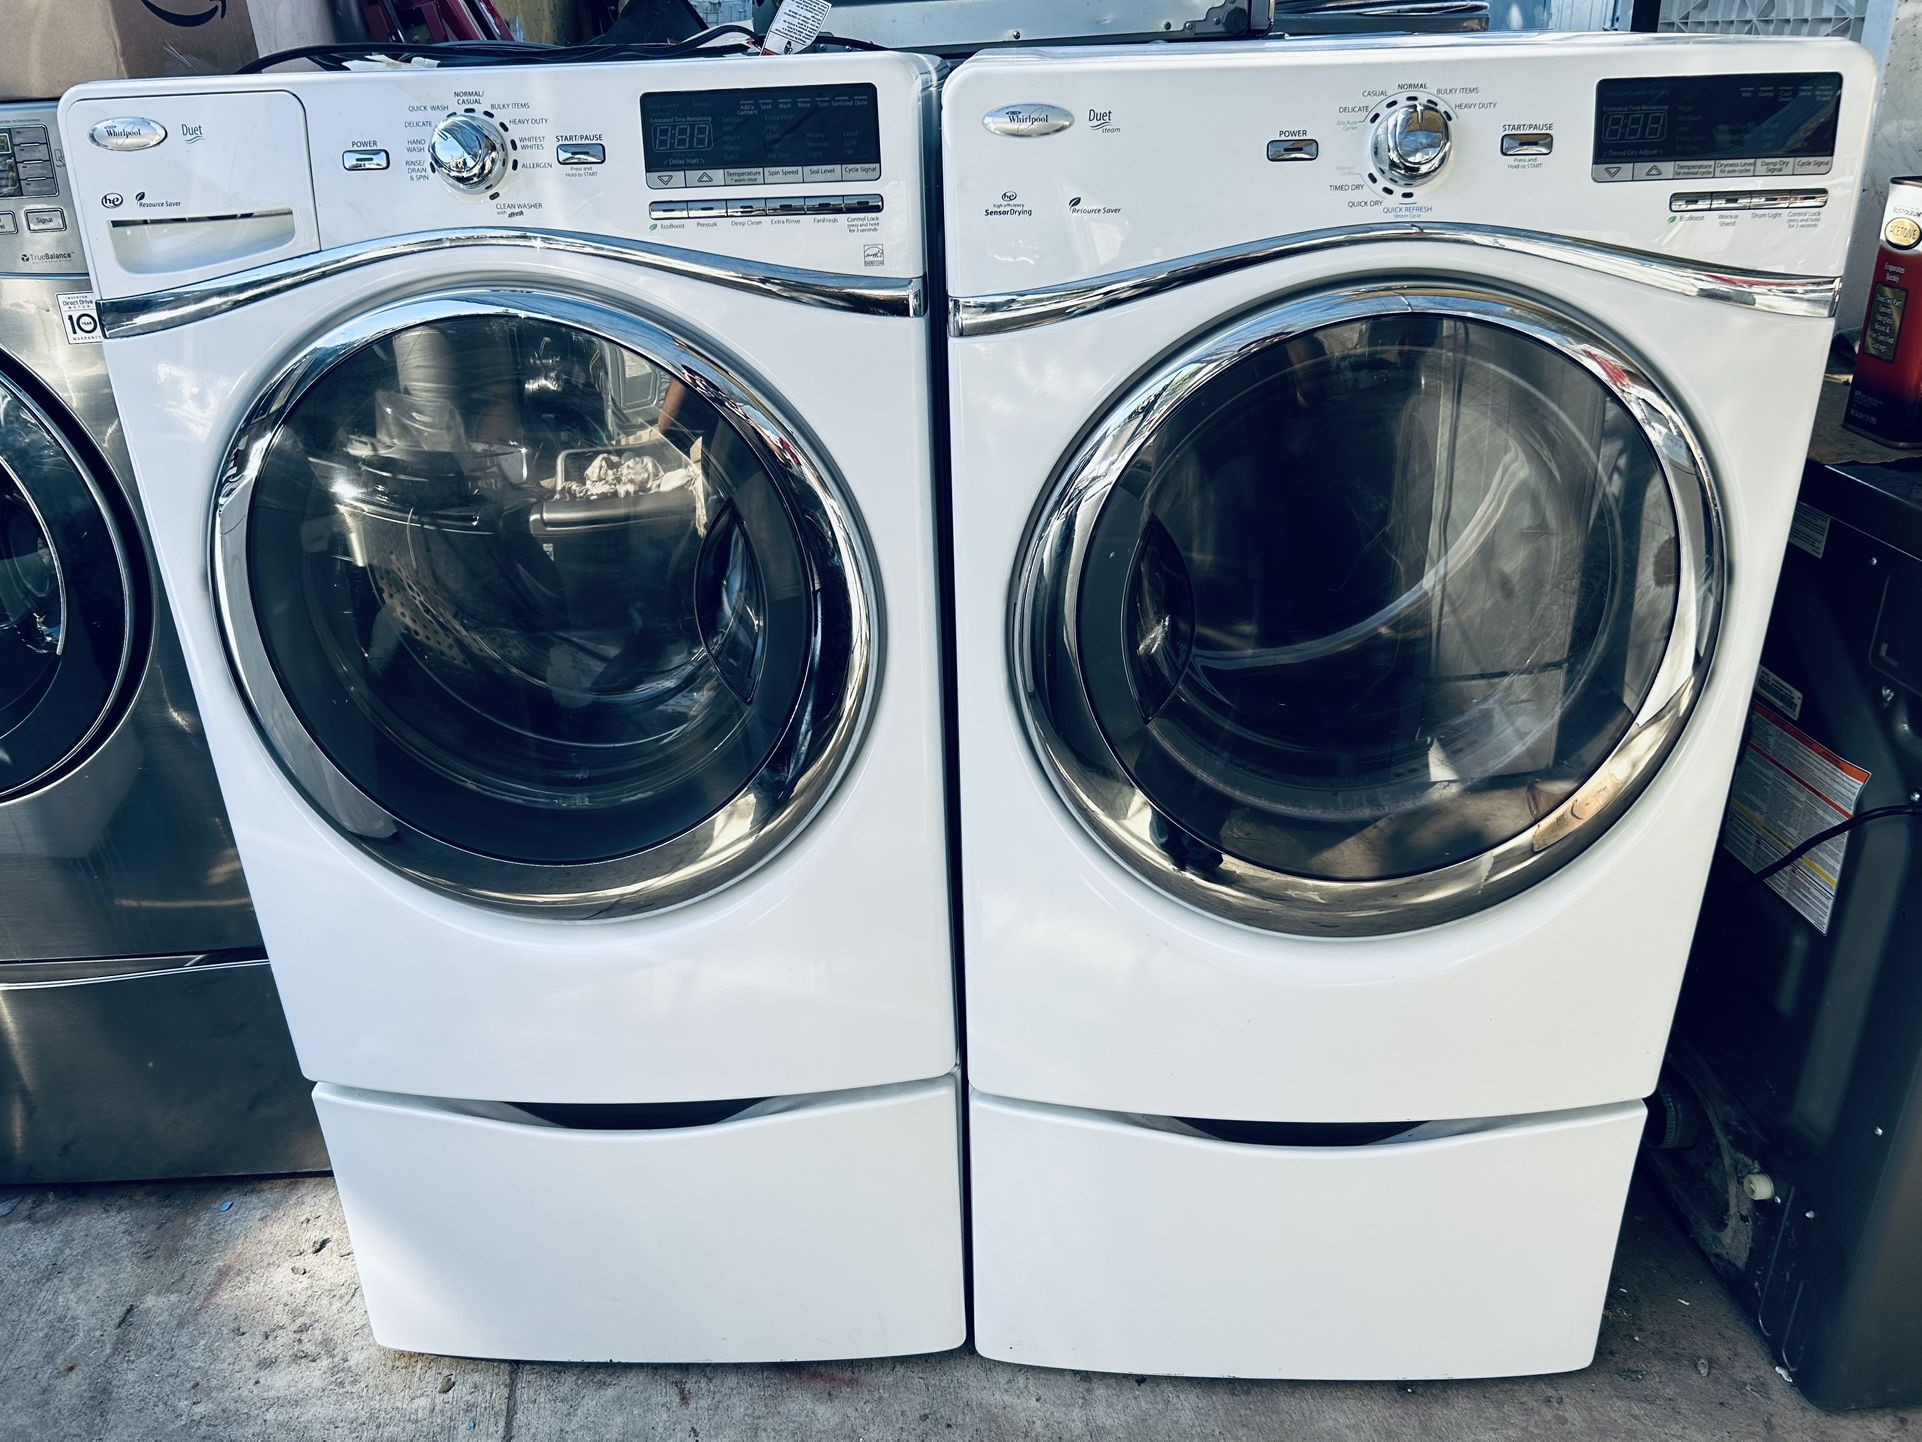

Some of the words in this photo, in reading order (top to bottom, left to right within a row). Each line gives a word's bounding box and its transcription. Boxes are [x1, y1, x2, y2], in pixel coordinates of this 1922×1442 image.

[1455, 102, 1476, 110] HEAVY
[1089, 109, 1112, 122] Duet
[1008, 115, 1048, 125] Whirlpool
[182, 124, 202, 136] Duet
[1502, 123, 1553, 131] START/PAUSE
[106, 128, 140, 137] Whirlpool
[1279, 130, 1307, 138] POWER
[556, 134, 603, 142] START/PAUSE
[352, 140, 377, 148] POWER
[985, 208, 1032, 216] SensorDrying
[1890, 224, 1917, 239] ACETONE
[68, 313, 98, 334] 10
